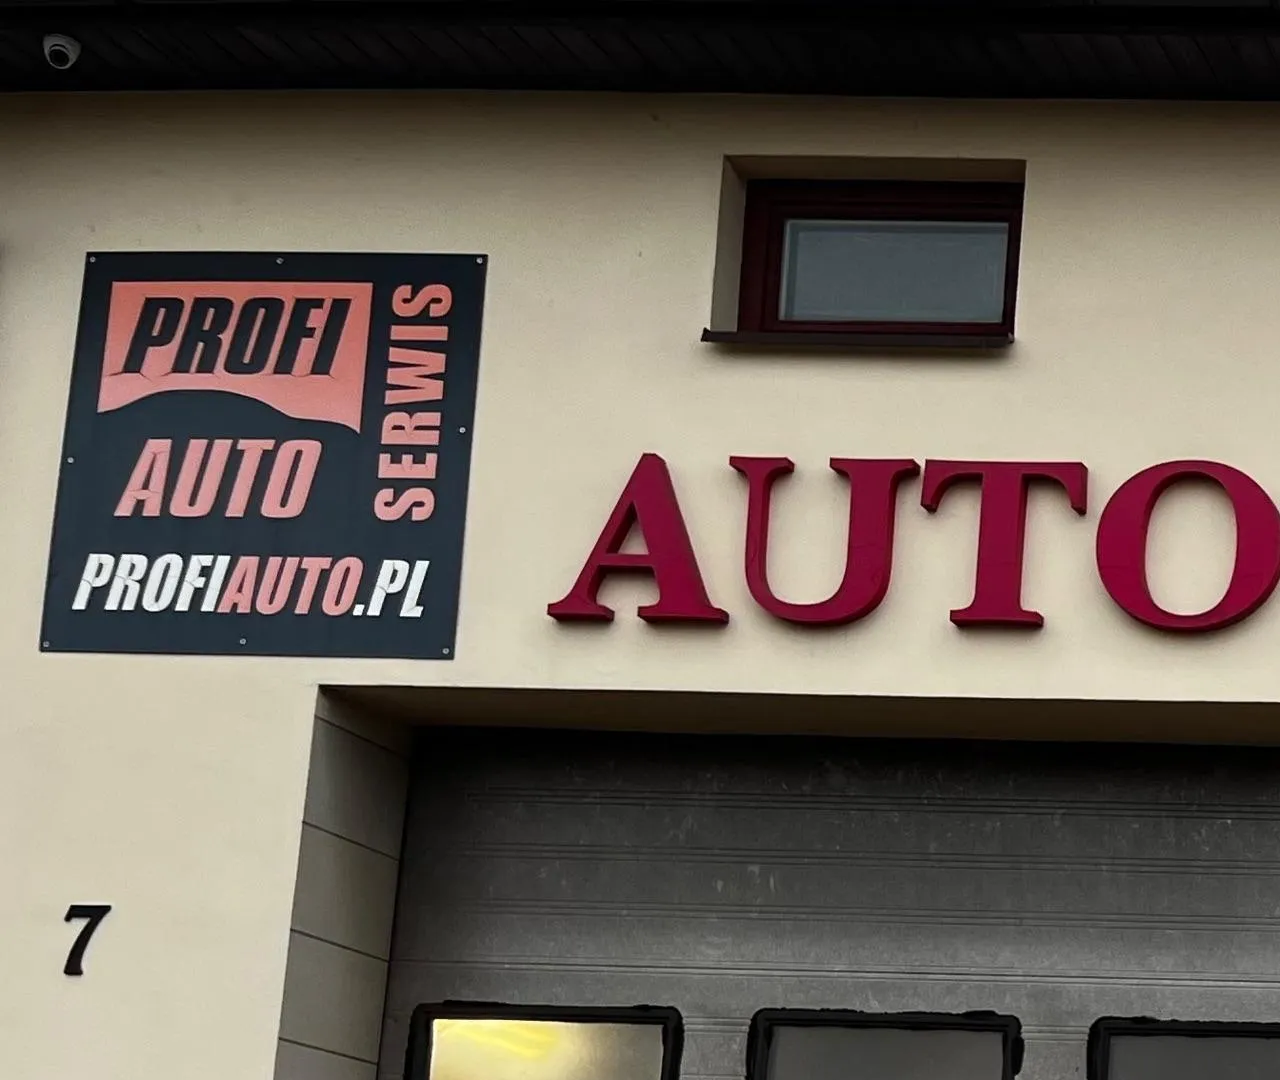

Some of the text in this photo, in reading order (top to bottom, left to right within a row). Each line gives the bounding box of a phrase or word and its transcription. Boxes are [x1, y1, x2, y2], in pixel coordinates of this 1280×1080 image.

[122, 296, 353, 378] PROFI
[374, 283, 453, 522] SERWIS
[113, 438, 323, 519] AUTO
[71, 553, 430, 618] PROFIAUTO.PL
[63, 904, 113, 976] 7
